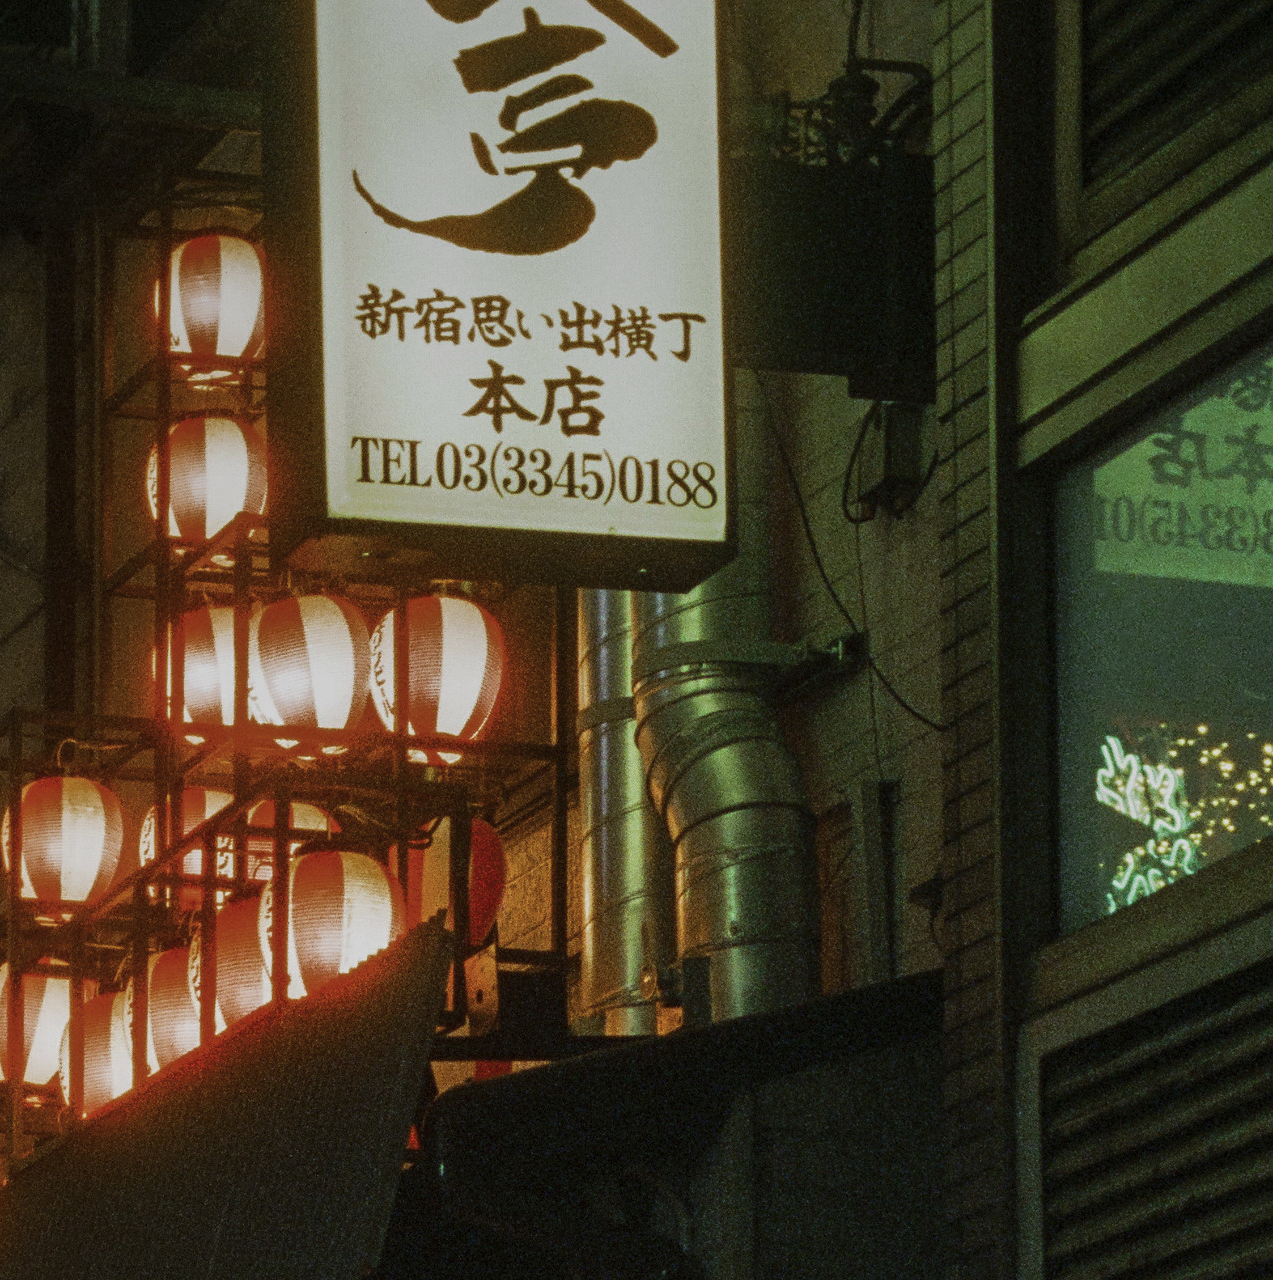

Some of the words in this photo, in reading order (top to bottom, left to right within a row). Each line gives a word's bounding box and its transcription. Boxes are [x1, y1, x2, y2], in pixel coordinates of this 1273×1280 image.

[354, 283, 707, 362] 新宿思い出横丁
[462, 359, 606, 437] 本店
